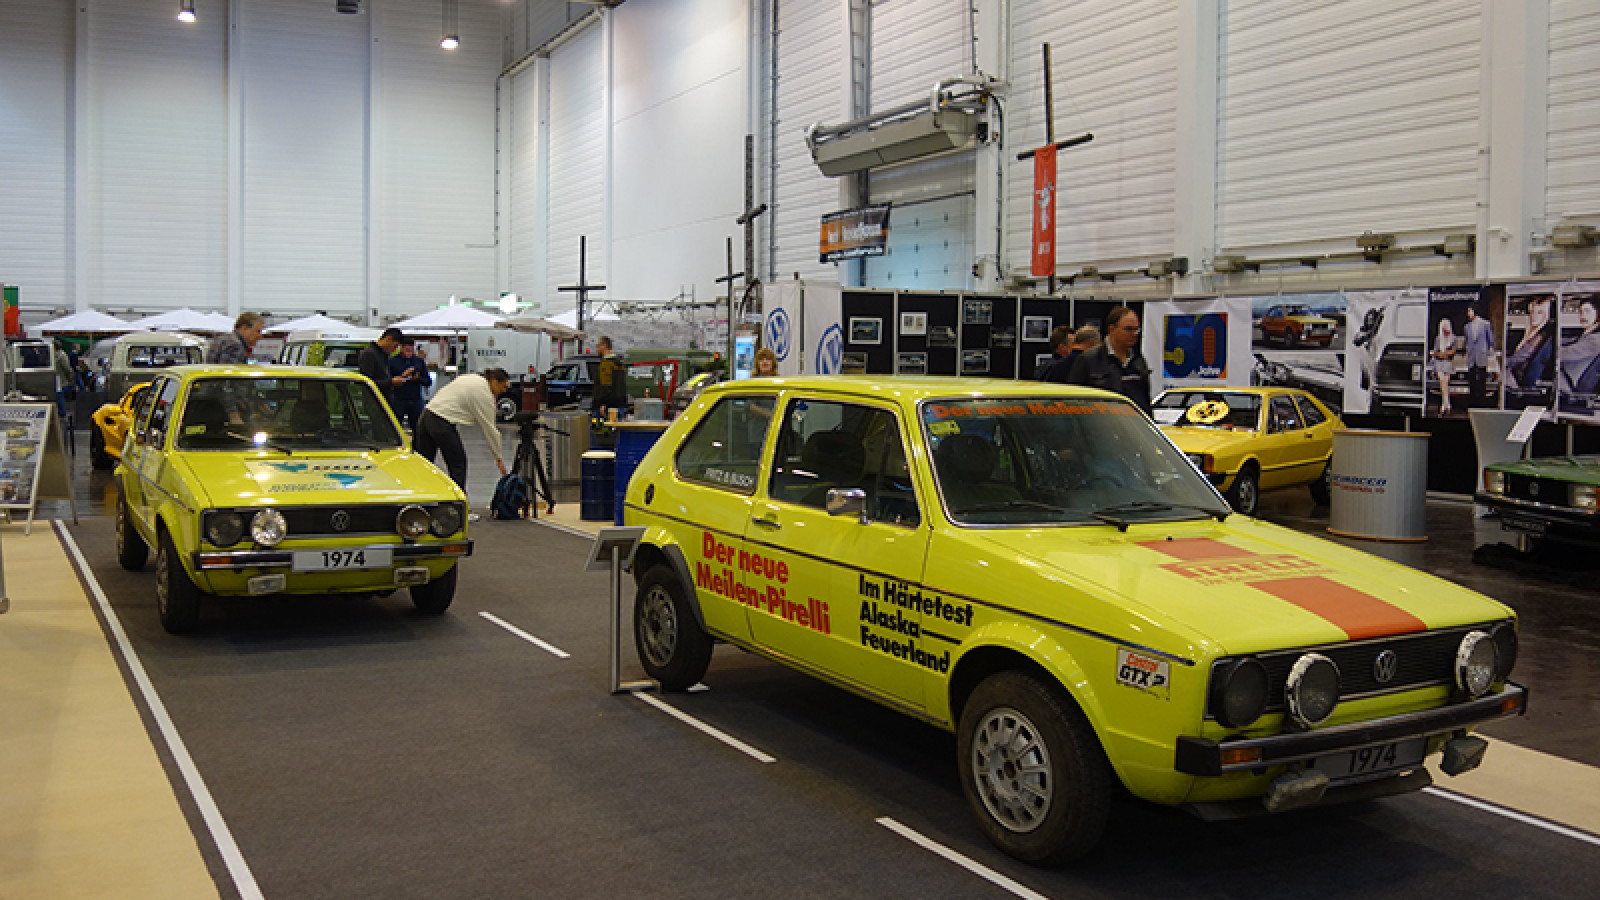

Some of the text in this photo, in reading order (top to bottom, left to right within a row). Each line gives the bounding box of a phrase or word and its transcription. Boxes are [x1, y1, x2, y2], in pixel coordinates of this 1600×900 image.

[930, 404, 971, 419] Der
[976, 405, 1028, 417] neue
[321, 552, 367, 568] 1974
[703, 531, 789, 584] Der neue
[696, 561, 831, 635] Meilen-Pirelli
[859, 573, 881, 600] Im
[860, 625, 951, 674] Feuerland
[1119, 664, 1151, 686] GTX
[1348, 742, 1398, 774] 1974
